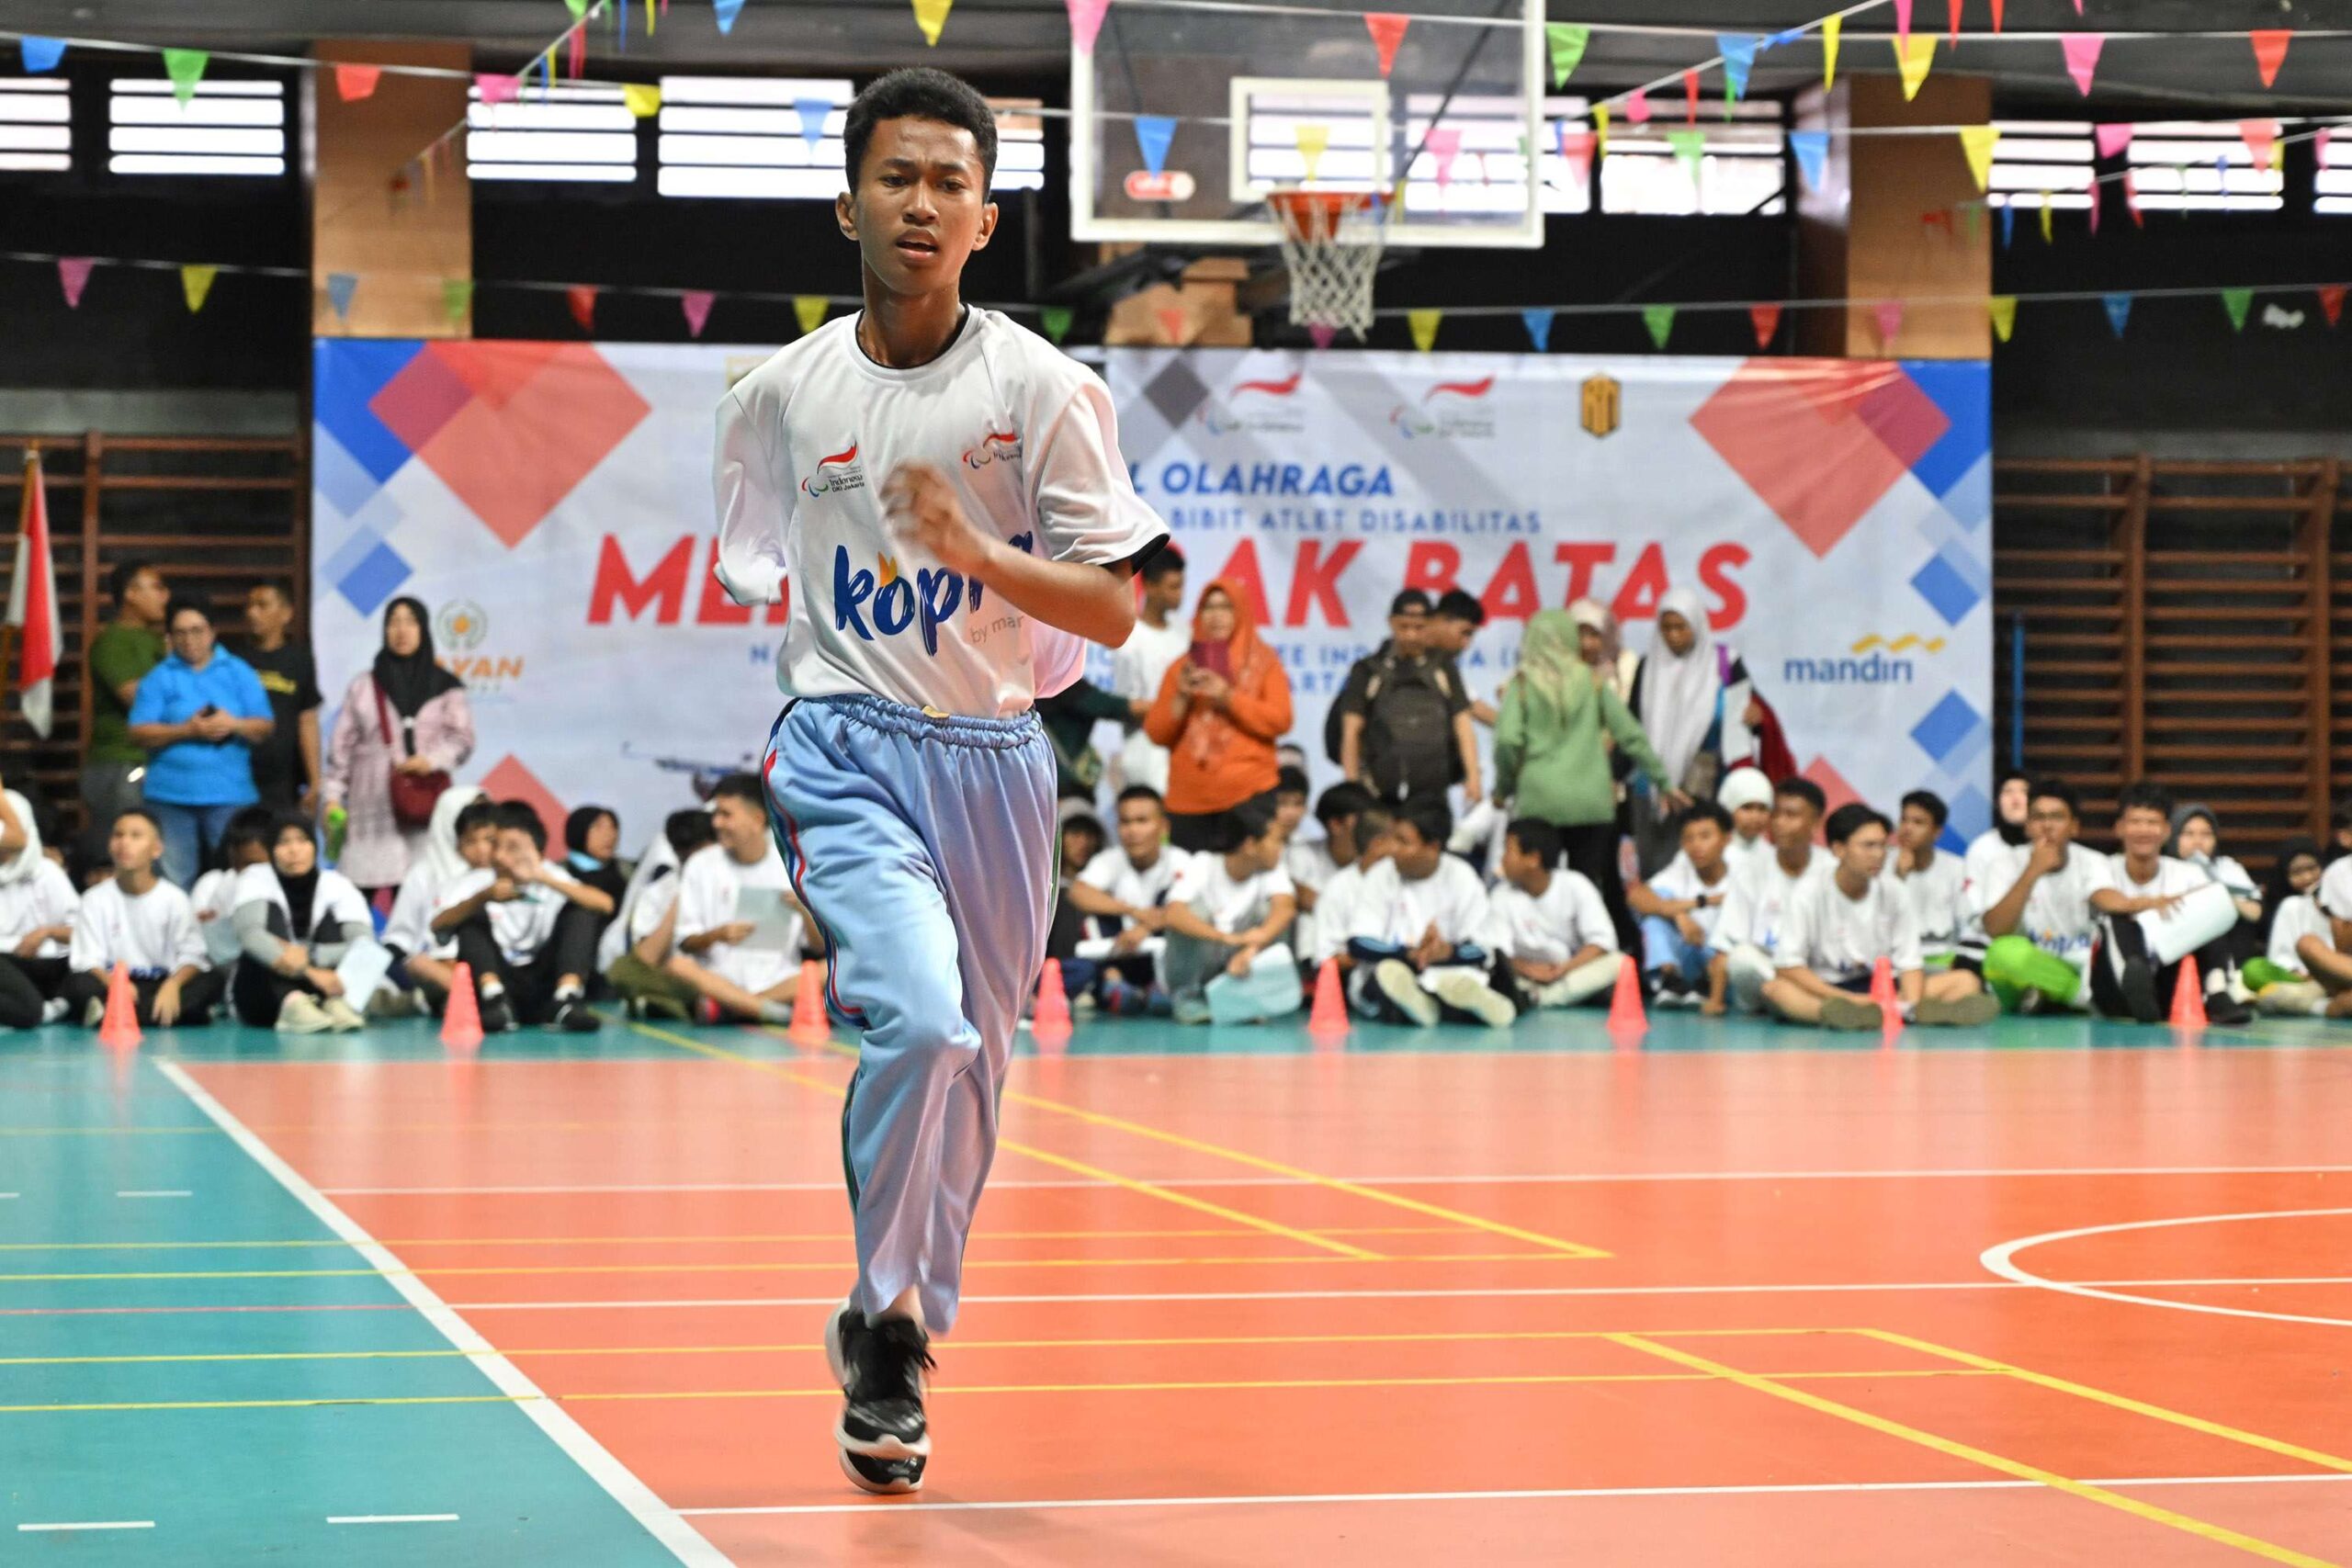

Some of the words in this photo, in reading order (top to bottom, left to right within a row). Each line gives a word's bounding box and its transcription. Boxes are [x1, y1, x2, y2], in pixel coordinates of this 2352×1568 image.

[1161, 462, 1394, 496] OLAHRAGA
[1170, 508, 1244, 530] BIBIT
[1261, 510, 1344, 533] ATLET
[1359, 510, 1542, 535] DISABILITAS
[1401, 539, 1753, 632] BATAS
[969, 626, 988, 643] by
[1783, 651, 1914, 682] mandiri
